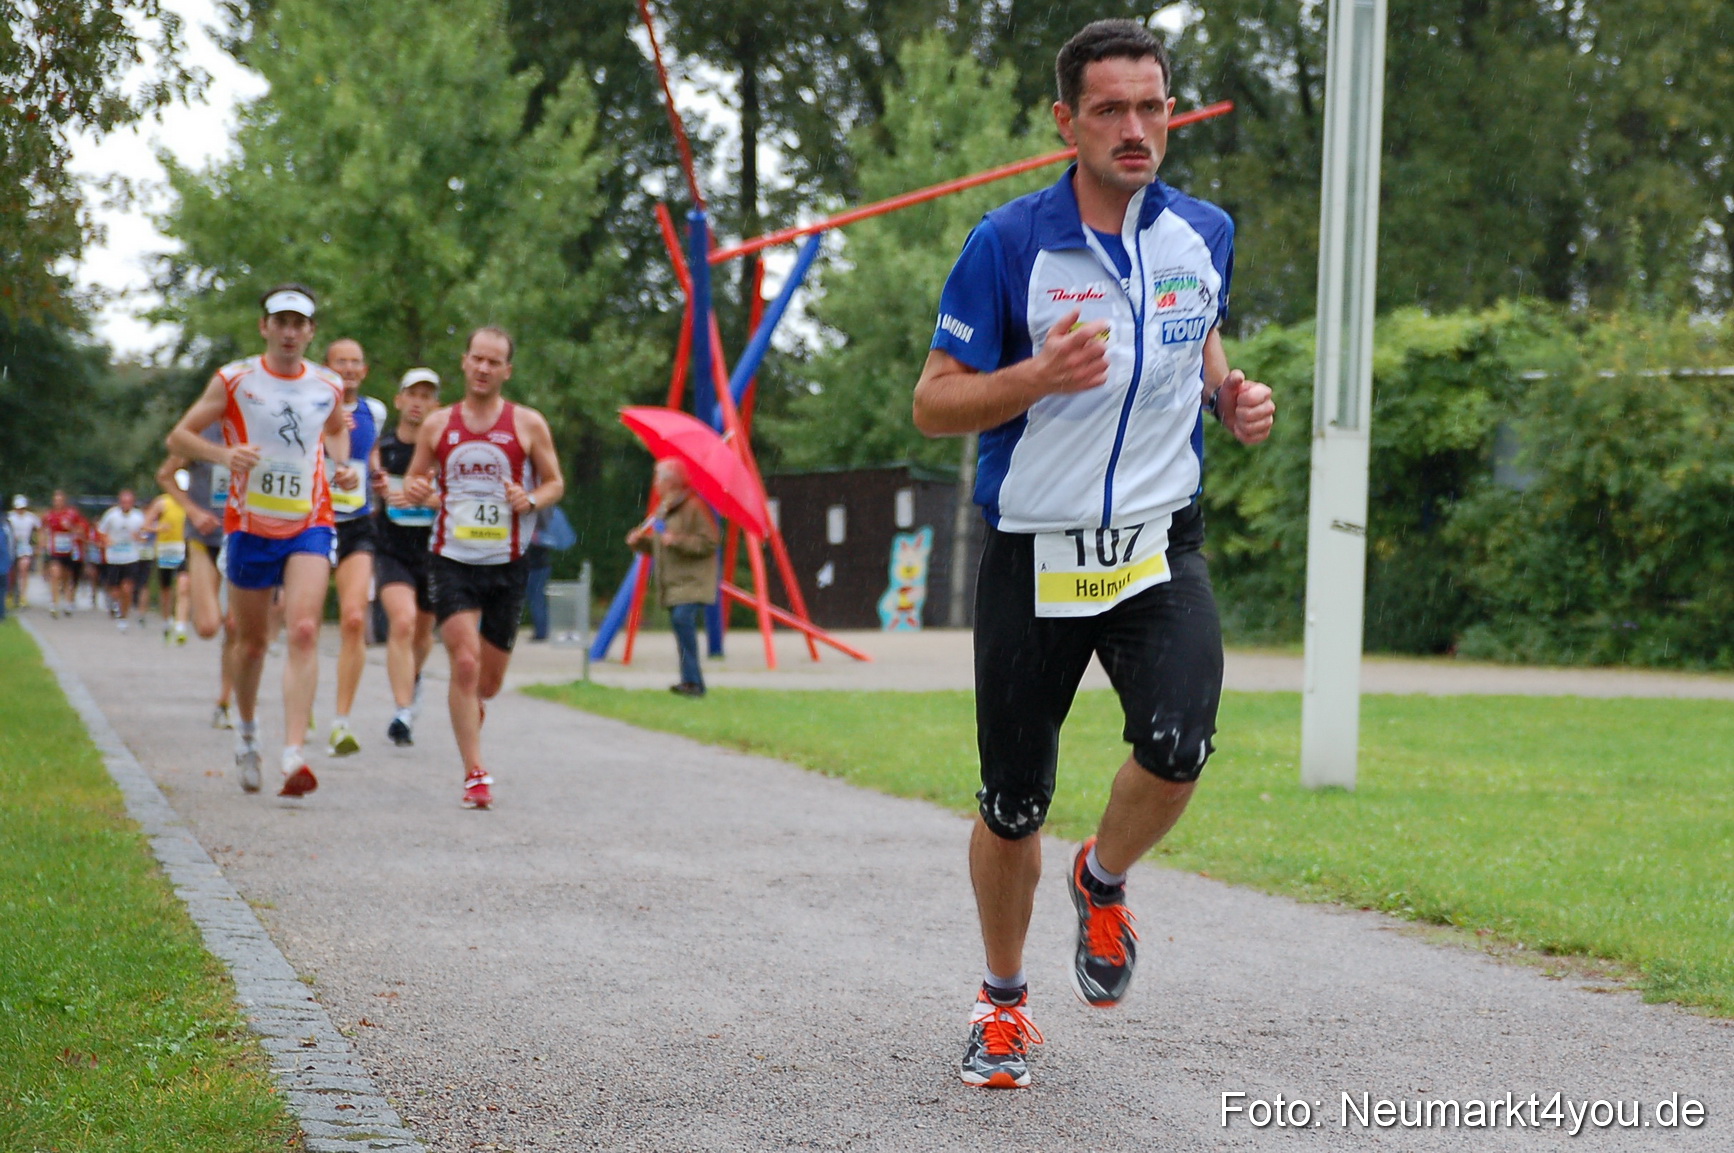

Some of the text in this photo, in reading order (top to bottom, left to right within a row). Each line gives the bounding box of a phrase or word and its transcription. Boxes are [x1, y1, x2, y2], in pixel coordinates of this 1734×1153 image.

[459, 463, 496, 475] LAC
[261, 472, 301, 498] 815
[475, 504, 499, 525] 43
[1065, 522, 1146, 567] 107
